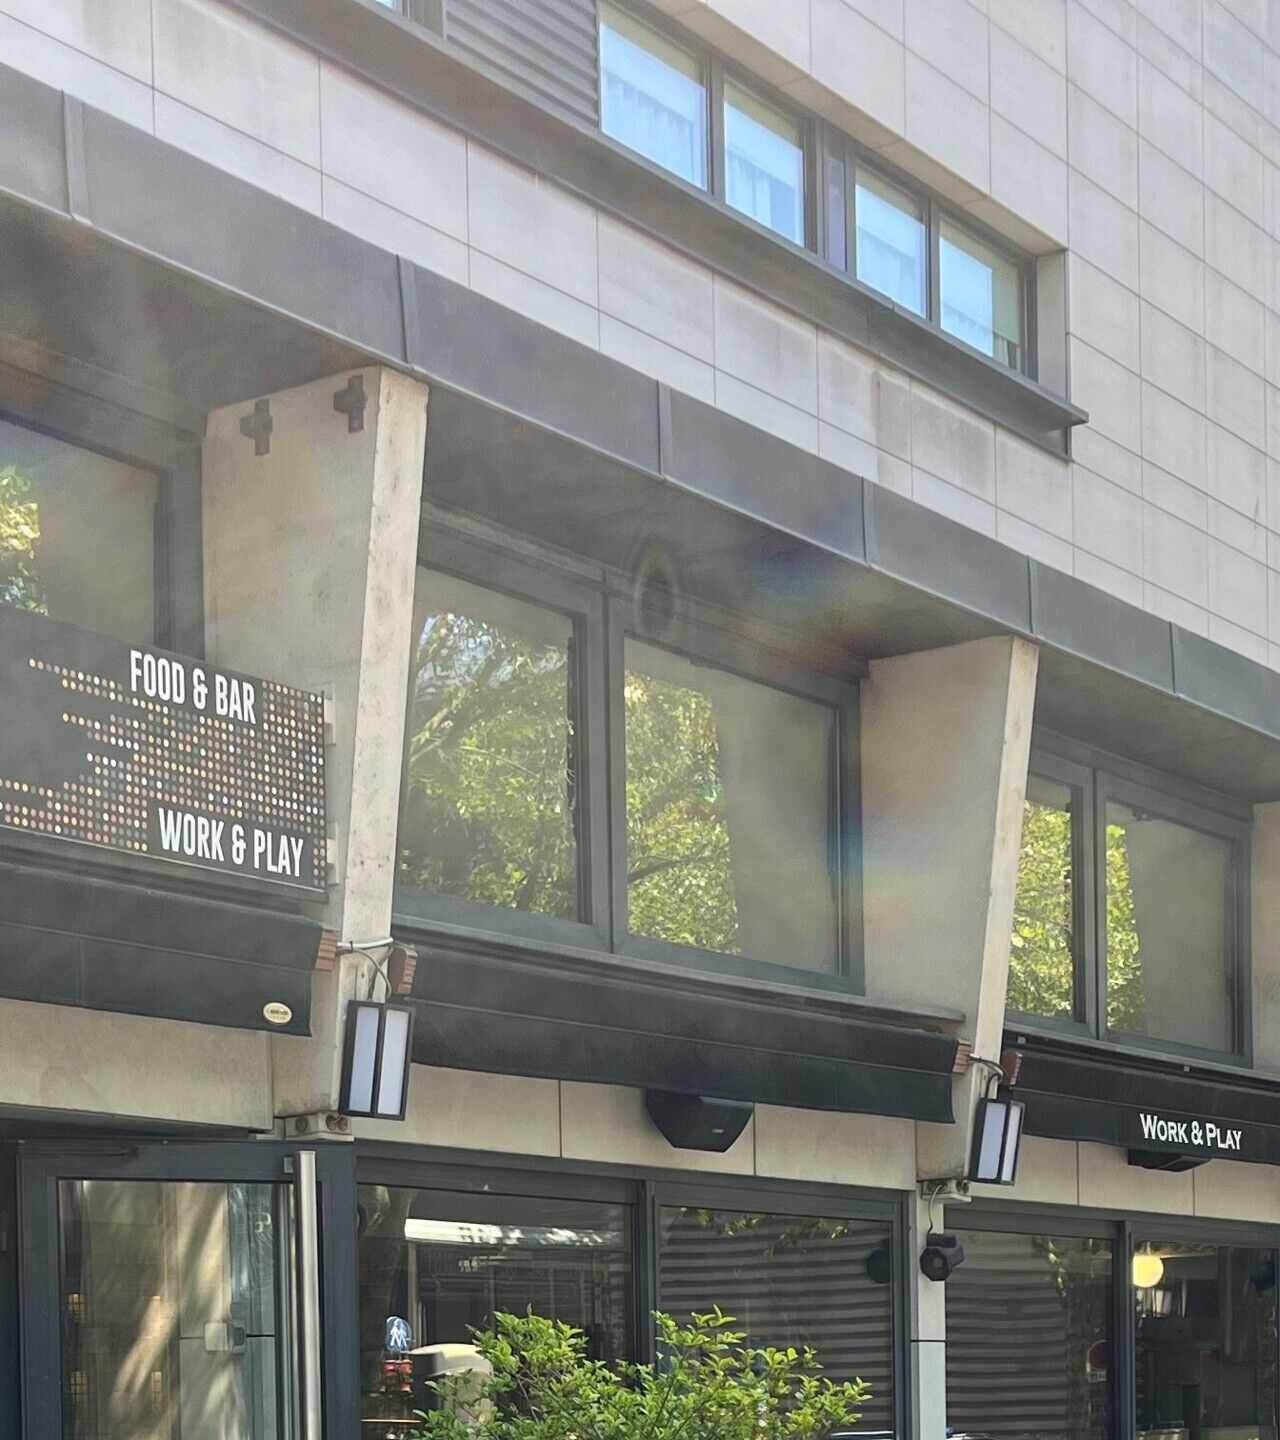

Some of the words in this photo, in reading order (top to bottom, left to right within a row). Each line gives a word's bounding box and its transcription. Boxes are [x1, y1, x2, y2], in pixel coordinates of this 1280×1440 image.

[129, 650, 187, 703] FOOD
[192, 668, 207, 709] &
[215, 672, 256, 725] BAR
[157, 808, 223, 862] WORK
[231, 824, 247, 865] &
[253, 829, 304, 877] PLAY
[1139, 1113, 1189, 1144] WORK
[1191, 1121, 1204, 1145] &
[1205, 1123, 1242, 1150] PLAY
